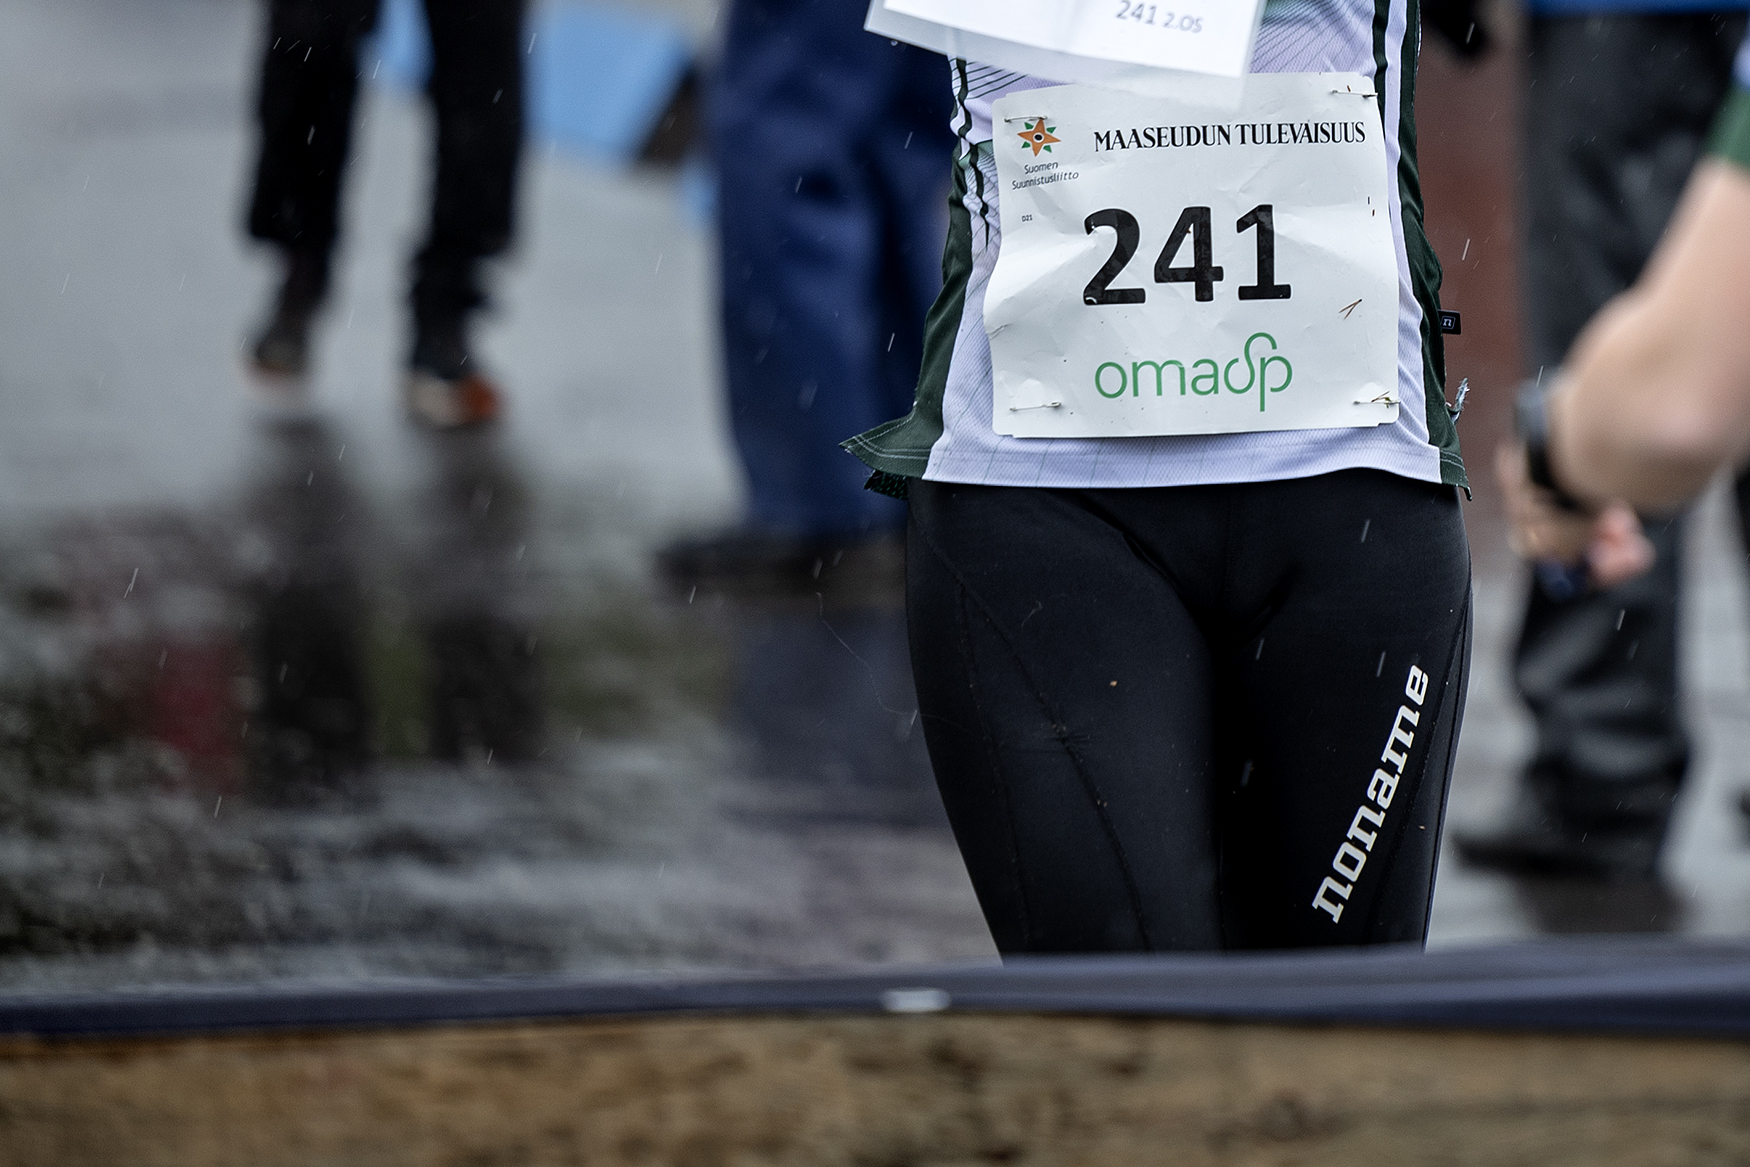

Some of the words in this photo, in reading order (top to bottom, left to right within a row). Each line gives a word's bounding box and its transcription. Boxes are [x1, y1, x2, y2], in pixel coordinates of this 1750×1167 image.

[1094, 124, 1231, 152] MAASEUDUN
[1235, 121, 1366, 145] TULEVAISUUS
[1012, 172, 1079, 190] Suunnistusliitto
[1024, 161, 1059, 175] Suomen
[1083, 204, 1292, 306] 241
[1312, 665, 1429, 924] noname
